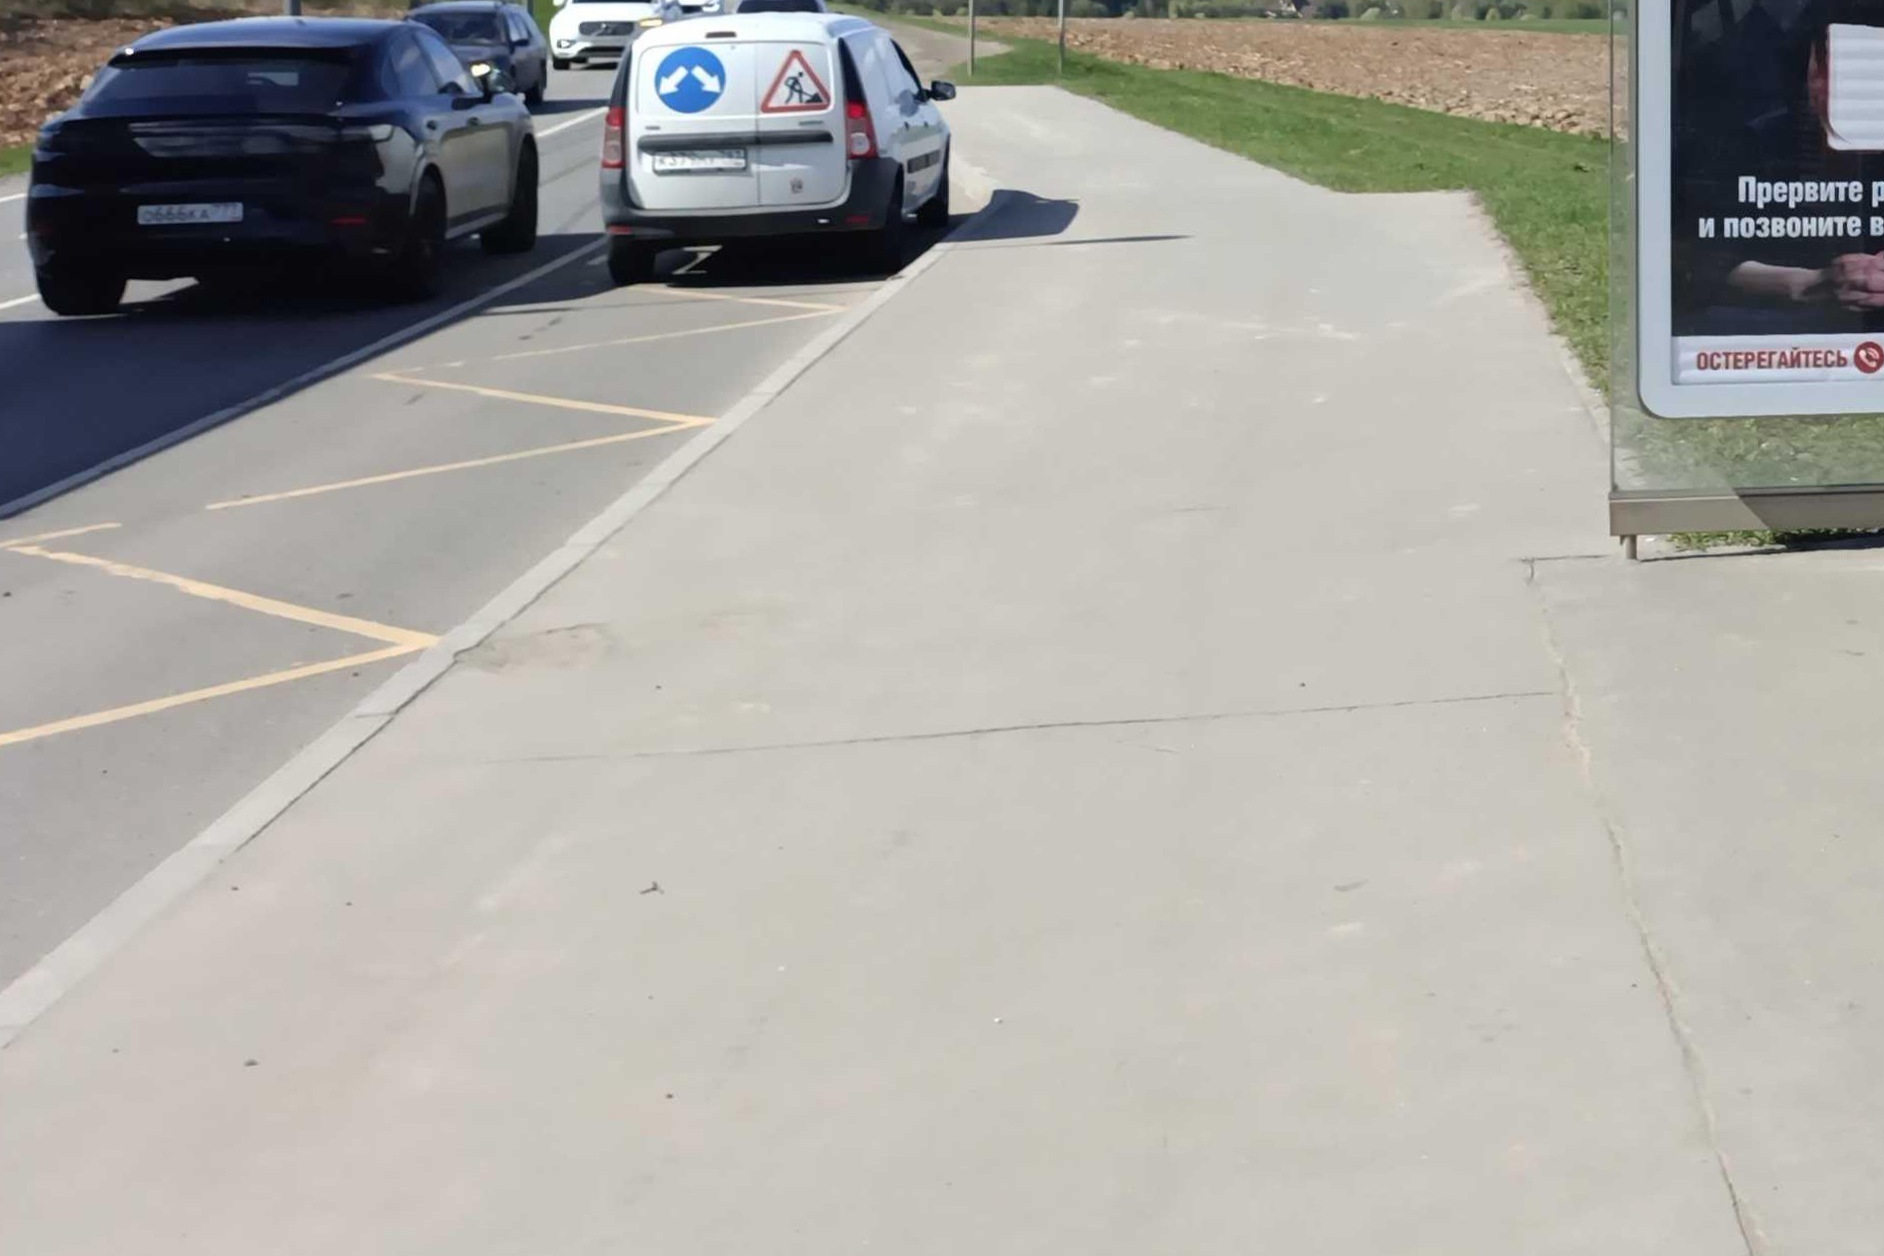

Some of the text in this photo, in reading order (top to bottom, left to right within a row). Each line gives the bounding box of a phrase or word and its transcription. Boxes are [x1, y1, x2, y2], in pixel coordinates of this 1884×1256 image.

[1738, 176, 1863, 208] Прервите
[1698, 216, 1715, 238] и
[1723, 214, 1862, 238] позвоните
[1870, 216, 1884, 236] в
[1696, 347, 1848, 371] ОСТЕРЕГАЙТЕСЬ
